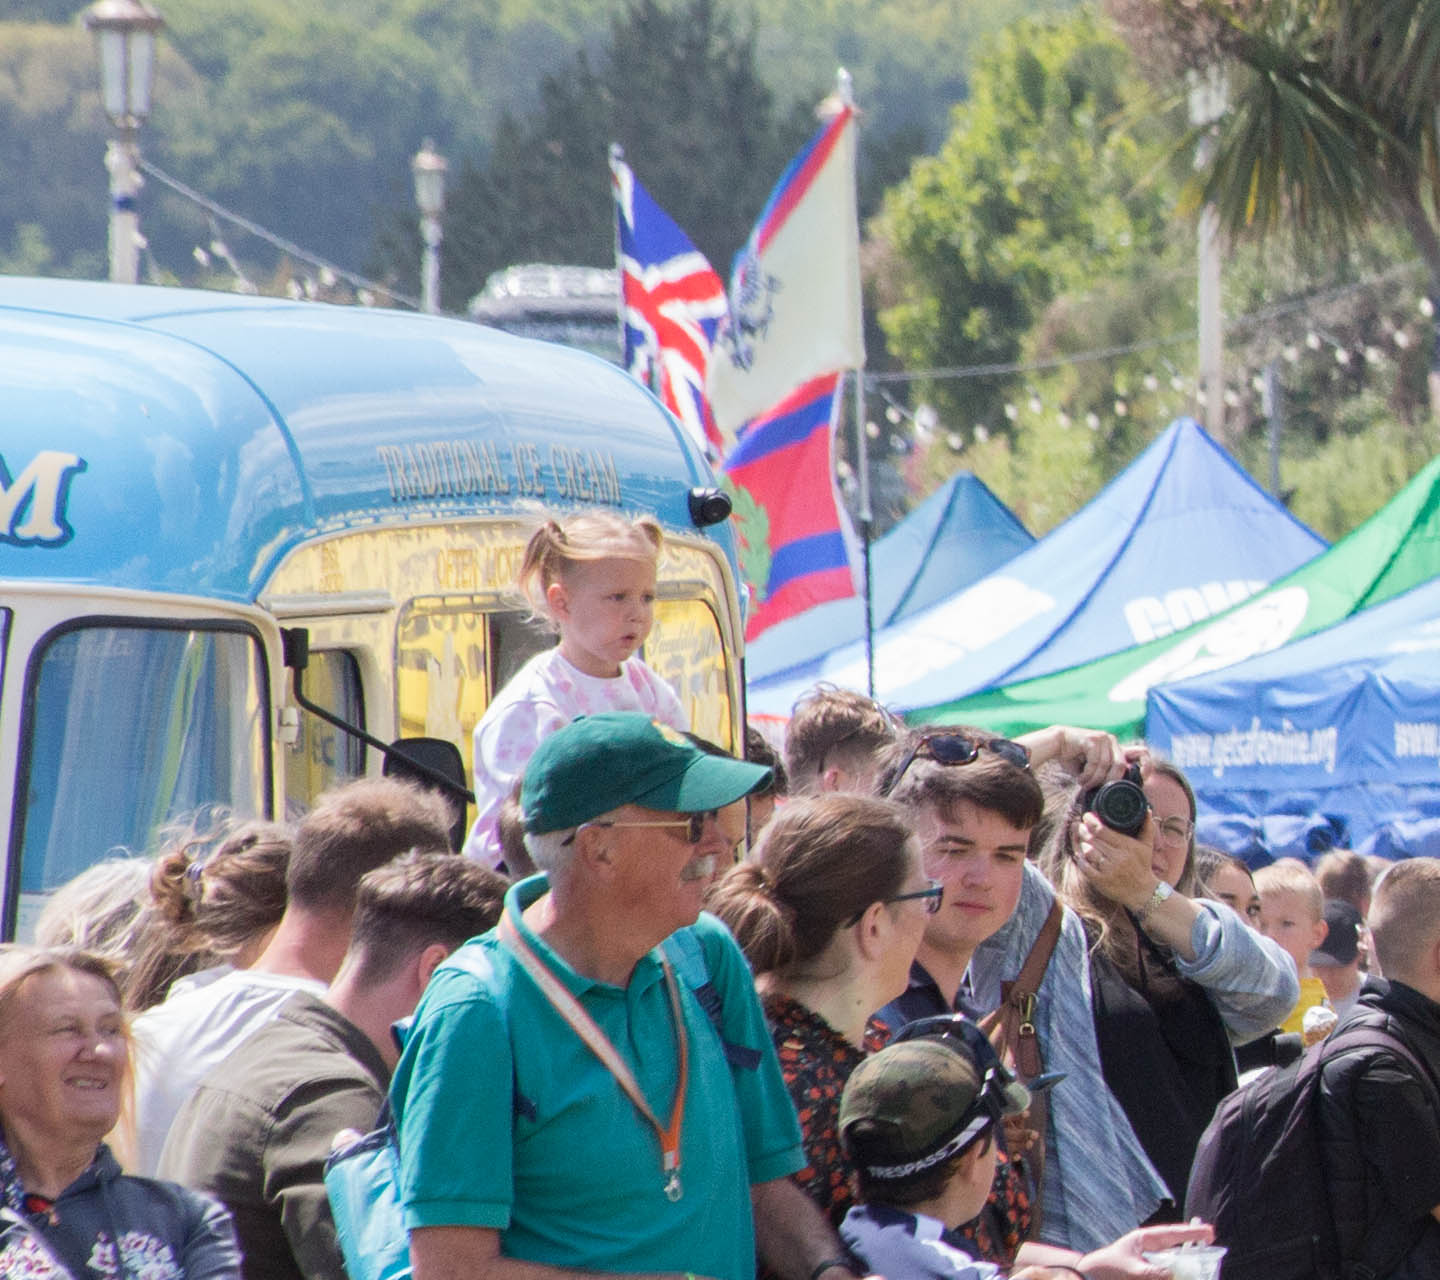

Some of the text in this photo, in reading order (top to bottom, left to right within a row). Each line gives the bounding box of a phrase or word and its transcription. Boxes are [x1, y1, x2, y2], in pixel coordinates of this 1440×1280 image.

[375, 439, 623, 507] TRADITIONAL ICE CREAM
